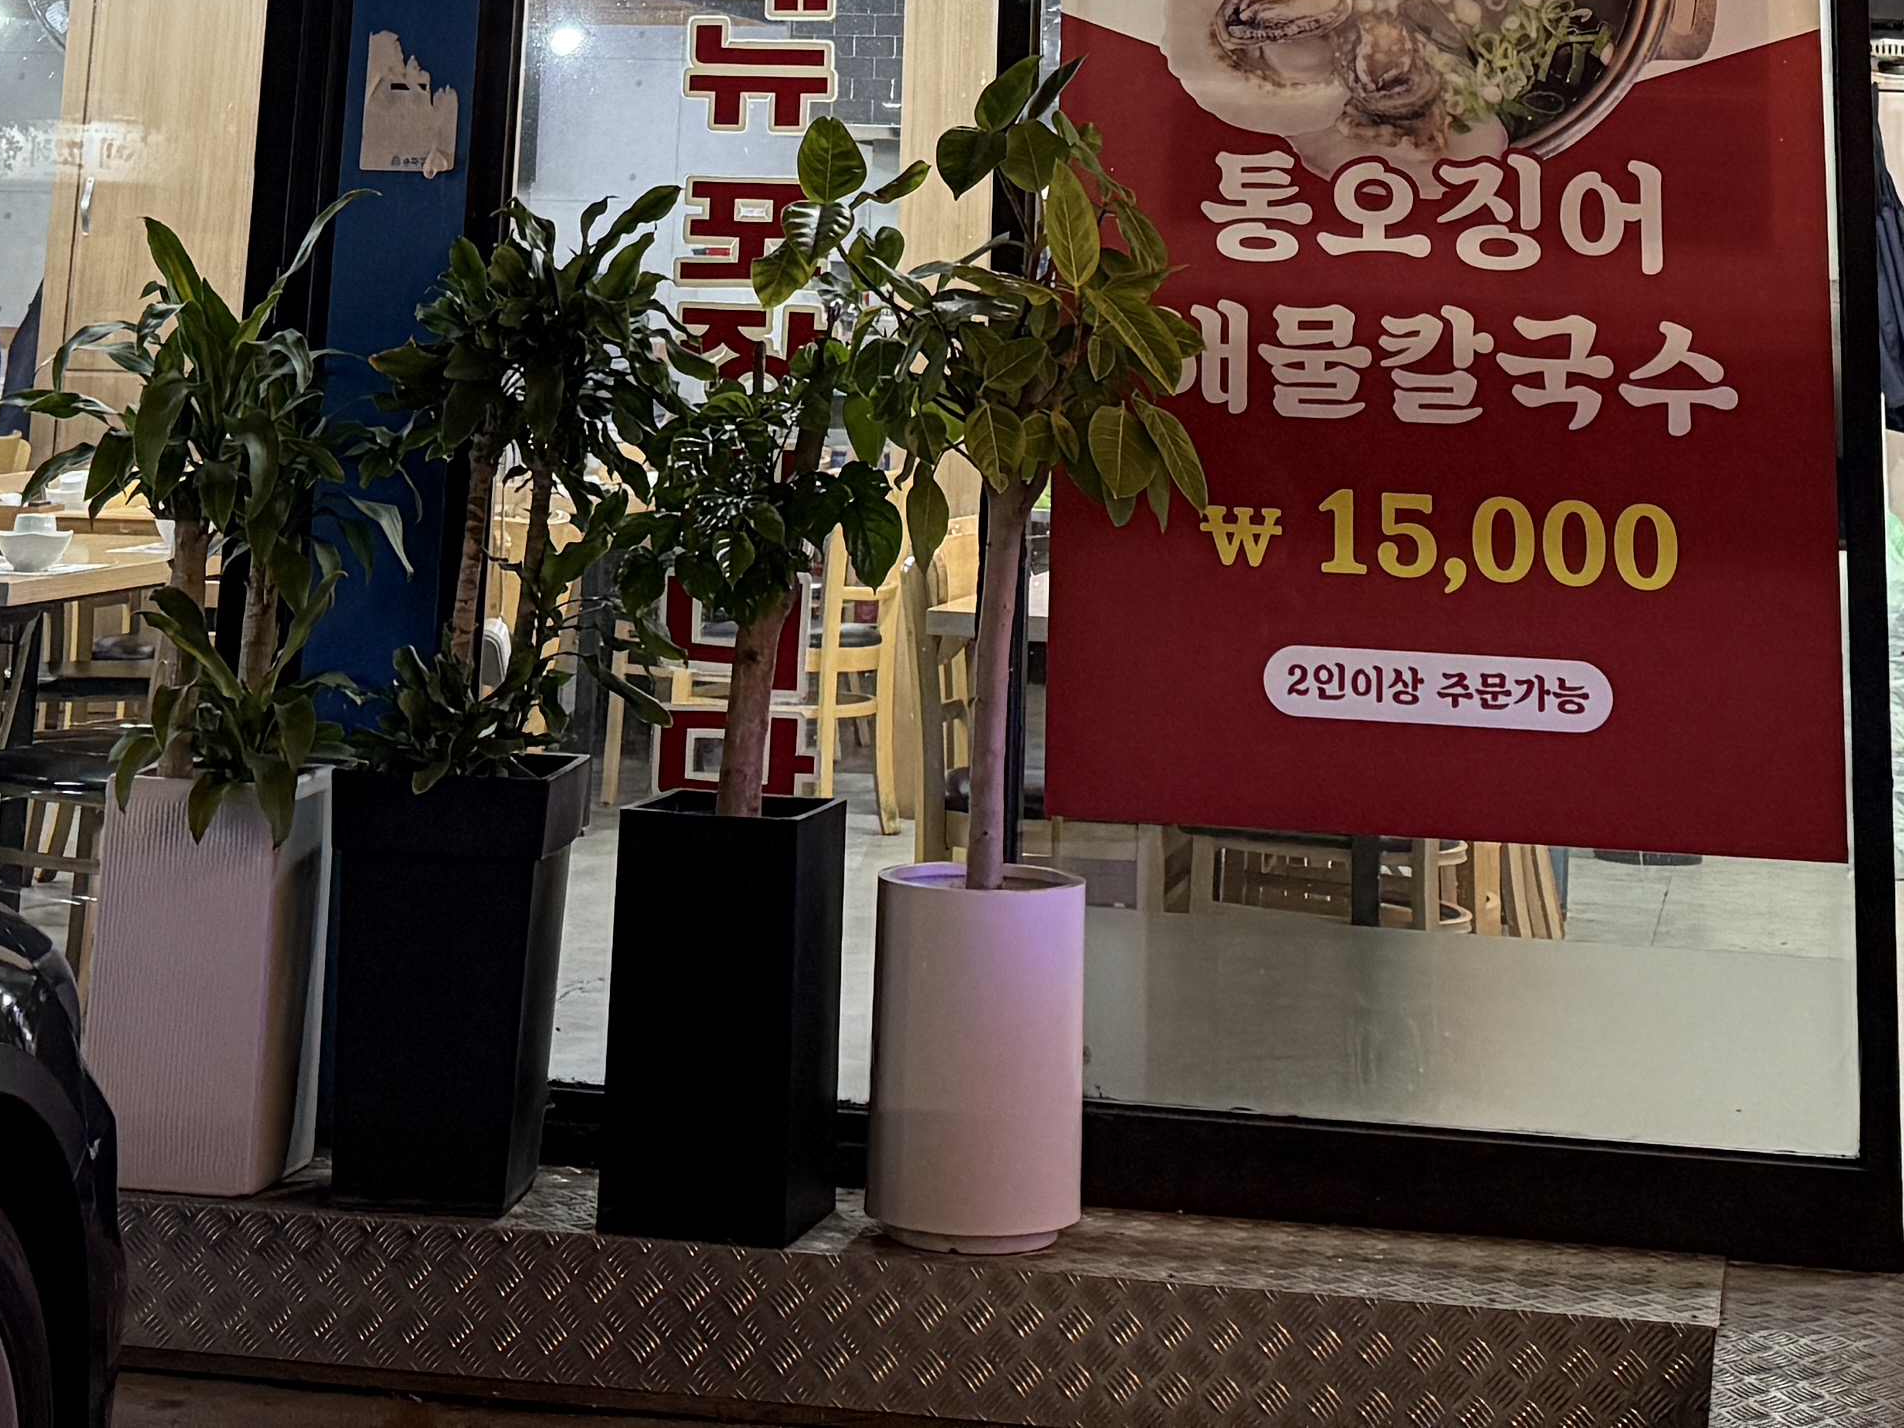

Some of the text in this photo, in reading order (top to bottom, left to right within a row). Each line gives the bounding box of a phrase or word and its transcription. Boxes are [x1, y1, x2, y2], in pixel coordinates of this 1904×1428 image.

[1199, 149, 1665, 276] 통오징어
[1317, 488, 1680, 595] 15,000
[1286, 661, 1591, 716] 2인이상 주문가능
